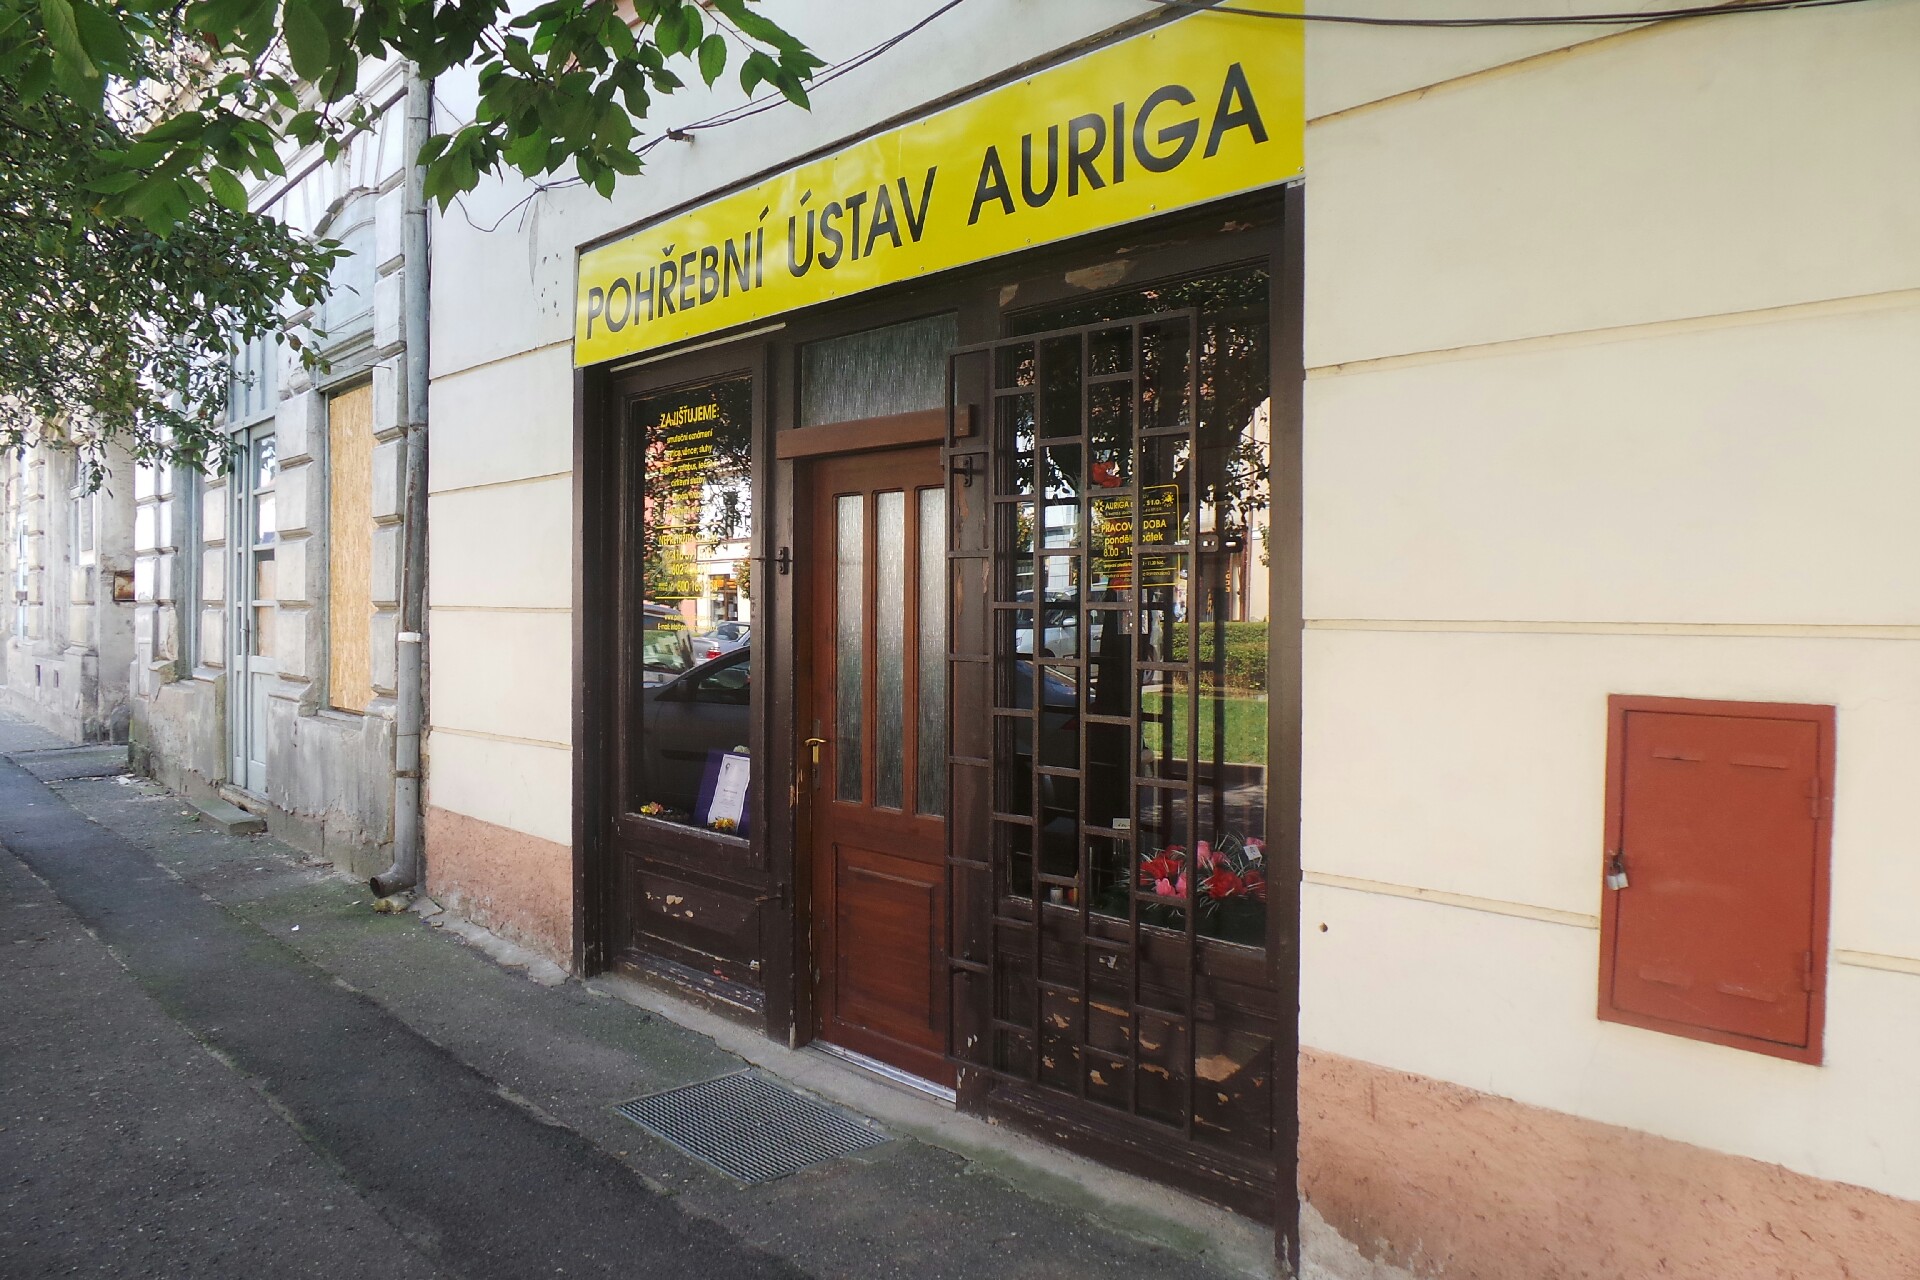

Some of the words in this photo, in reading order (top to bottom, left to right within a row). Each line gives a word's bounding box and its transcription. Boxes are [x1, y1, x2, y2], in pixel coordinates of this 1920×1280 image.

[585, 204, 770, 340] POHŘEBNÍ
[787, 165, 938, 278] ÚSTAV
[966, 61, 1270, 226] AURIGA
[660, 404, 719, 428] ZAJIŠŤUJEME:
[1105, 502, 1130, 510] AURIGA
[1101, 522, 1133, 533] PRACOV
[1143, 519, 1166, 529] DOBA
[1105, 534, 1133, 547] ponděl
